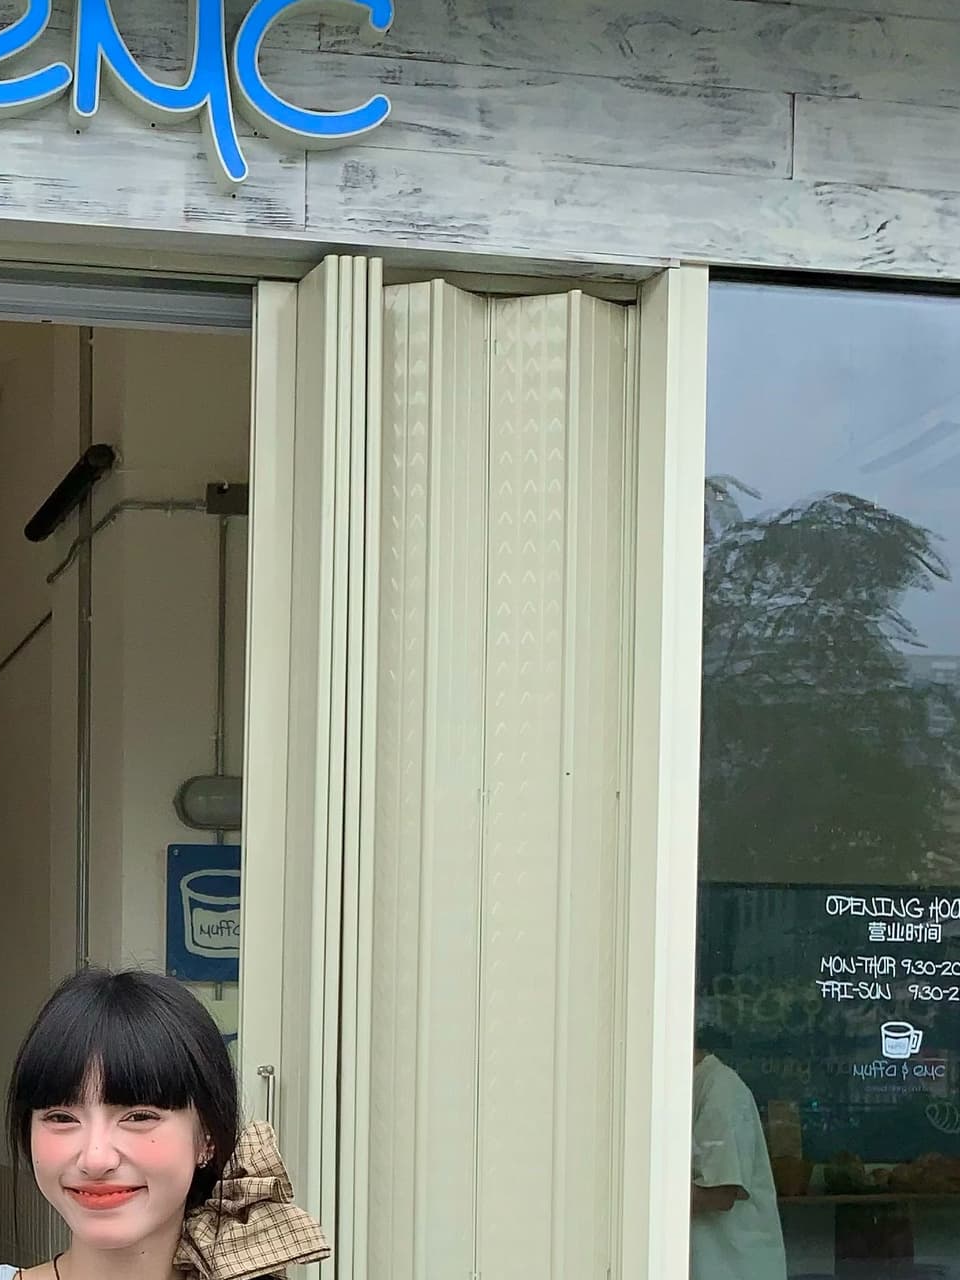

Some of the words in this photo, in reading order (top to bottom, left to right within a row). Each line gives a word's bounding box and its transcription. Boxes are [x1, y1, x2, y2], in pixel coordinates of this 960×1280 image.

[826, 896, 924, 918] OPENING
[868, 921, 942, 944] 营业时间
[815, 980, 892, 1002] FRI-SUN
